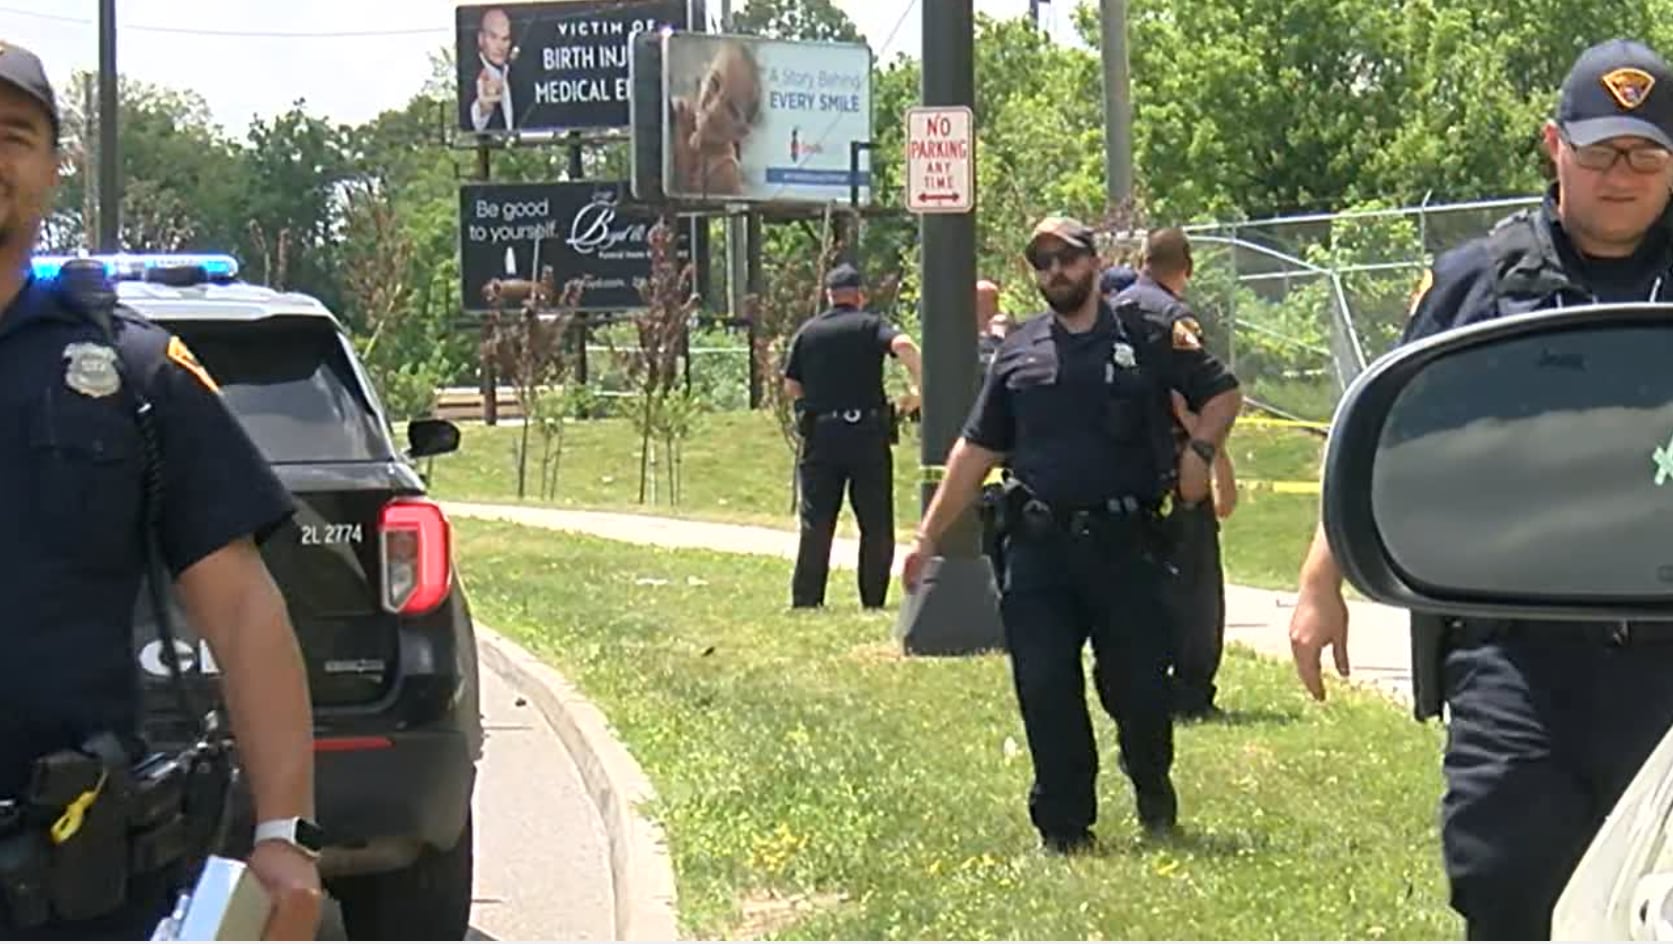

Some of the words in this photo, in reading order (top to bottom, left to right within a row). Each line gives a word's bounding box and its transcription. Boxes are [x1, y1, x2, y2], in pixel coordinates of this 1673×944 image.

[557, 20, 623, 36] VICTIM
[632, 18, 655, 33] OF
[543, 46, 594, 70] BIRTH
[535, 79, 610, 103] MEDICAL
[770, 91, 815, 110] EVERY
[820, 94, 860, 112] SMILE
[927, 117, 951, 137] NO
[911, 140, 967, 159] PARKING
[927, 162, 951, 173] ANY
[925, 176, 953, 189] TIME
[476, 200, 499, 218] Be
[502, 198, 549, 221] good
[469, 225, 487, 241] to
[301, 524, 321, 545] 2L
[324, 523, 362, 544] 2774
